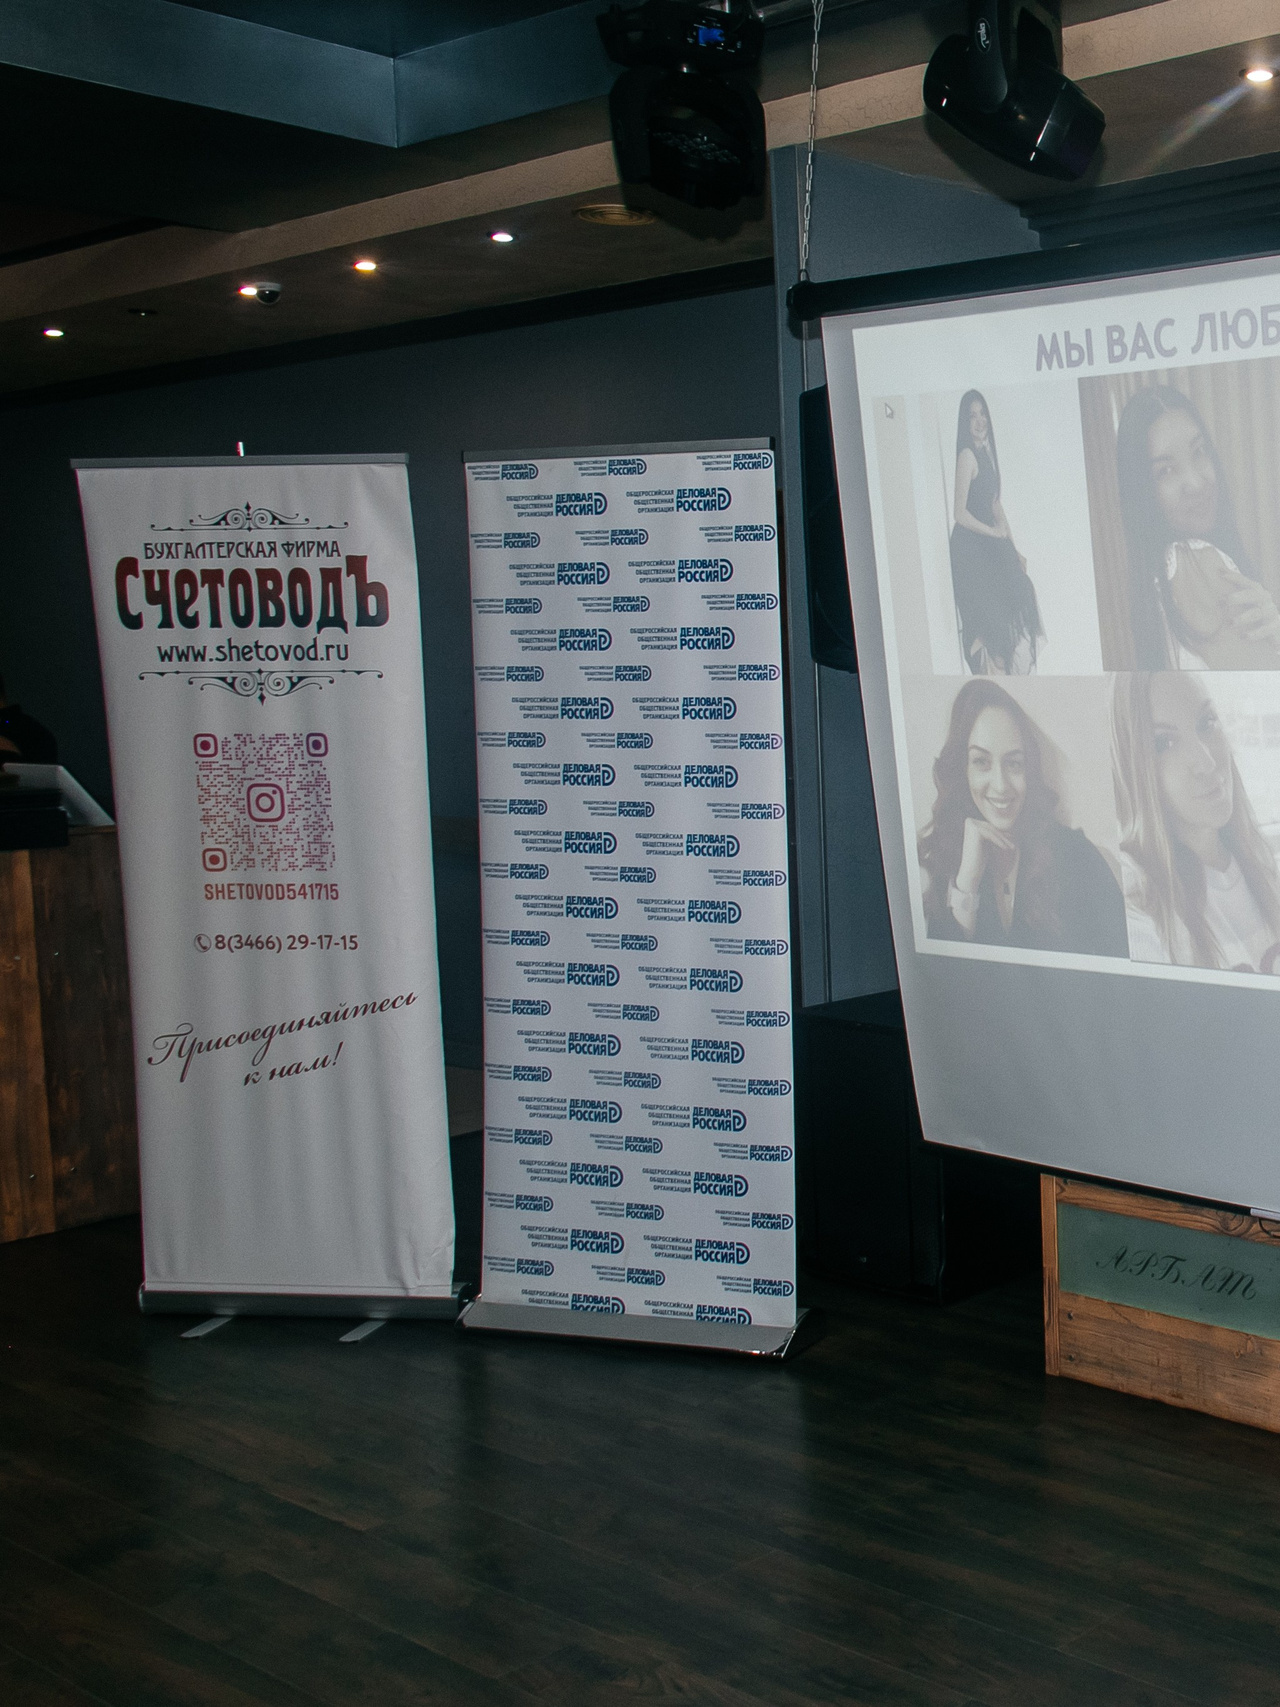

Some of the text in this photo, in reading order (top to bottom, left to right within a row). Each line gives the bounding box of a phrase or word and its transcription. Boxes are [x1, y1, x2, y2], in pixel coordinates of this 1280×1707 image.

[1036, 328, 1094, 372] МЫ
[1106, 318, 1178, 364] ВАС
[733, 460, 762, 470] РОССИЯ
[608, 466, 637, 476] РОССИЯ
[555, 493, 593, 505] ДЕЛОВАЯ
[676, 487, 716, 500] ДЕЛОВАЯ
[555, 503, 593, 517] РОССИЯ
[676, 499, 717, 512] РОССИЯ
[610, 536, 638, 546] РОССИЯ
[734, 532, 764, 542] РОССИЯ
[144, 540, 342, 560] БУХГАЛТЕРСКАЯ ФИРМА
[557, 562, 595, 574] ДЕЛОВАЯ
[678, 559, 719, 570] ДЕЛОВАЯ
[557, 573, 596, 585] РОССИЯ
[678, 570, 719, 583] РОССИЯ
[613, 603, 640, 613] РОССИЯ
[736, 601, 766, 610] РОССИЯ
[559, 628, 597, 640] ДЕЛОВАЯ
[680, 627, 721, 638] ДЕЛОВАЯ
[559, 639, 598, 651] РОССИЯ
[680, 638, 721, 650] РОССИЯ
[157, 637, 349, 663] www.shetovod.ru
[615, 672, 642, 682] РОССИЯ
[738, 672, 768, 681] РОССИЯ
[560, 697, 599, 707] ДЕЛОВАЯ
[682, 697, 722, 708] ДЕЛОВАЯ
[561, 708, 599, 719] РОССИЯ
[682, 708, 723, 720] РОССИЯ
[617, 739, 644, 749] РОССИЯ
[739, 740, 770, 750] РОССИЯ
[562, 763, 601, 774] ДЕЛОВАЯ
[684, 765, 724, 775] ДЕЛОВАЯ
[562, 773, 601, 786] РОССИЯ
[684, 776, 724, 788] РОССИЯ
[618, 808, 646, 817] РОССИЯ
[741, 810, 772, 820] РОССИЯ
[564, 831, 602, 841] ДЕЛОВАЯ
[686, 834, 725, 844] ДЕЛОВАЯ
[564, 841, 603, 854] РОССИЯ
[686, 844, 726, 857] РОССИЯ
[620, 873, 647, 883] РОССИЯ
[743, 877, 774, 886] РОССИЯ
[204, 883, 339, 901] SHETOVOD541715
[566, 896, 604, 906] ДЕЛОВАЯ
[688, 900, 727, 910] ДЕЛОВАЯ
[566, 905, 604, 919] РОССИЯ
[688, 910, 727, 923] РОССИЯ
[214, 934, 359, 953] 8(3466) 29-17-15
[621, 941, 648, 951] РОССИЯ
[744, 946, 775, 955] РОССИЯ
[567, 963, 605, 973] ДЕЛОВАЯ
[690, 968, 728, 979] ДЕЛОВАЯ
[567, 973, 605, 986] РОССИЯ
[690, 979, 728, 992] РОССИЯ
[622, 1011, 650, 1021] РОССИЯ
[746, 1017, 778, 1027] РОССИЯ
[147, 991, 419, 1083] Присоединяйтесь
[568, 1032, 606, 1043] ДЕЛОВАЯ
[568, 1042, 607, 1056] РОССИЯ
[691, 1039, 730, 1050] ДЕЛОВАЯ
[691, 1049, 730, 1063] РОССИЯ
[243, 1041, 344, 1086] к нам!
[624, 1078, 651, 1088] РОССИЯ
[748, 1085, 779, 1096] РОССИЯ
[569, 1099, 607, 1110] ДЕЛОВАЯ
[569, 1109, 608, 1123] РОССИЯ
[692, 1106, 731, 1118] ДЕЛОВАЯ
[692, 1116, 732, 1131] РОССИЯ
[625, 1142, 653, 1153] РОССИЯ
[750, 1151, 780, 1161] РОССИЯ
[570, 1162, 609, 1174] ДЕЛОВАЯ
[570, 1172, 609, 1187] РОССИЯ
[693, 1171, 733, 1183] ДЕЛОВАЯ
[693, 1181, 733, 1196] РОССИЯ
[626, 1209, 654, 1220] РОССИЯ
[751, 1219, 781, 1230] РОССИЯ
[570, 1229, 610, 1241] ДЕЛОВАЯ
[570, 1238, 610, 1253] РОССИЯ
[695, 1239, 735, 1251] ДЕЛОВАЯ
[695, 1248, 735, 1264] РОССИЯ
[627, 1274, 655, 1285] РОССИЯ
[753, 1285, 782, 1296] РОССИЯ
[571, 1294, 610, 1306] ДЕЛОВАЯ
[696, 1304, 736, 1316] ДЕЛОВАЯ
